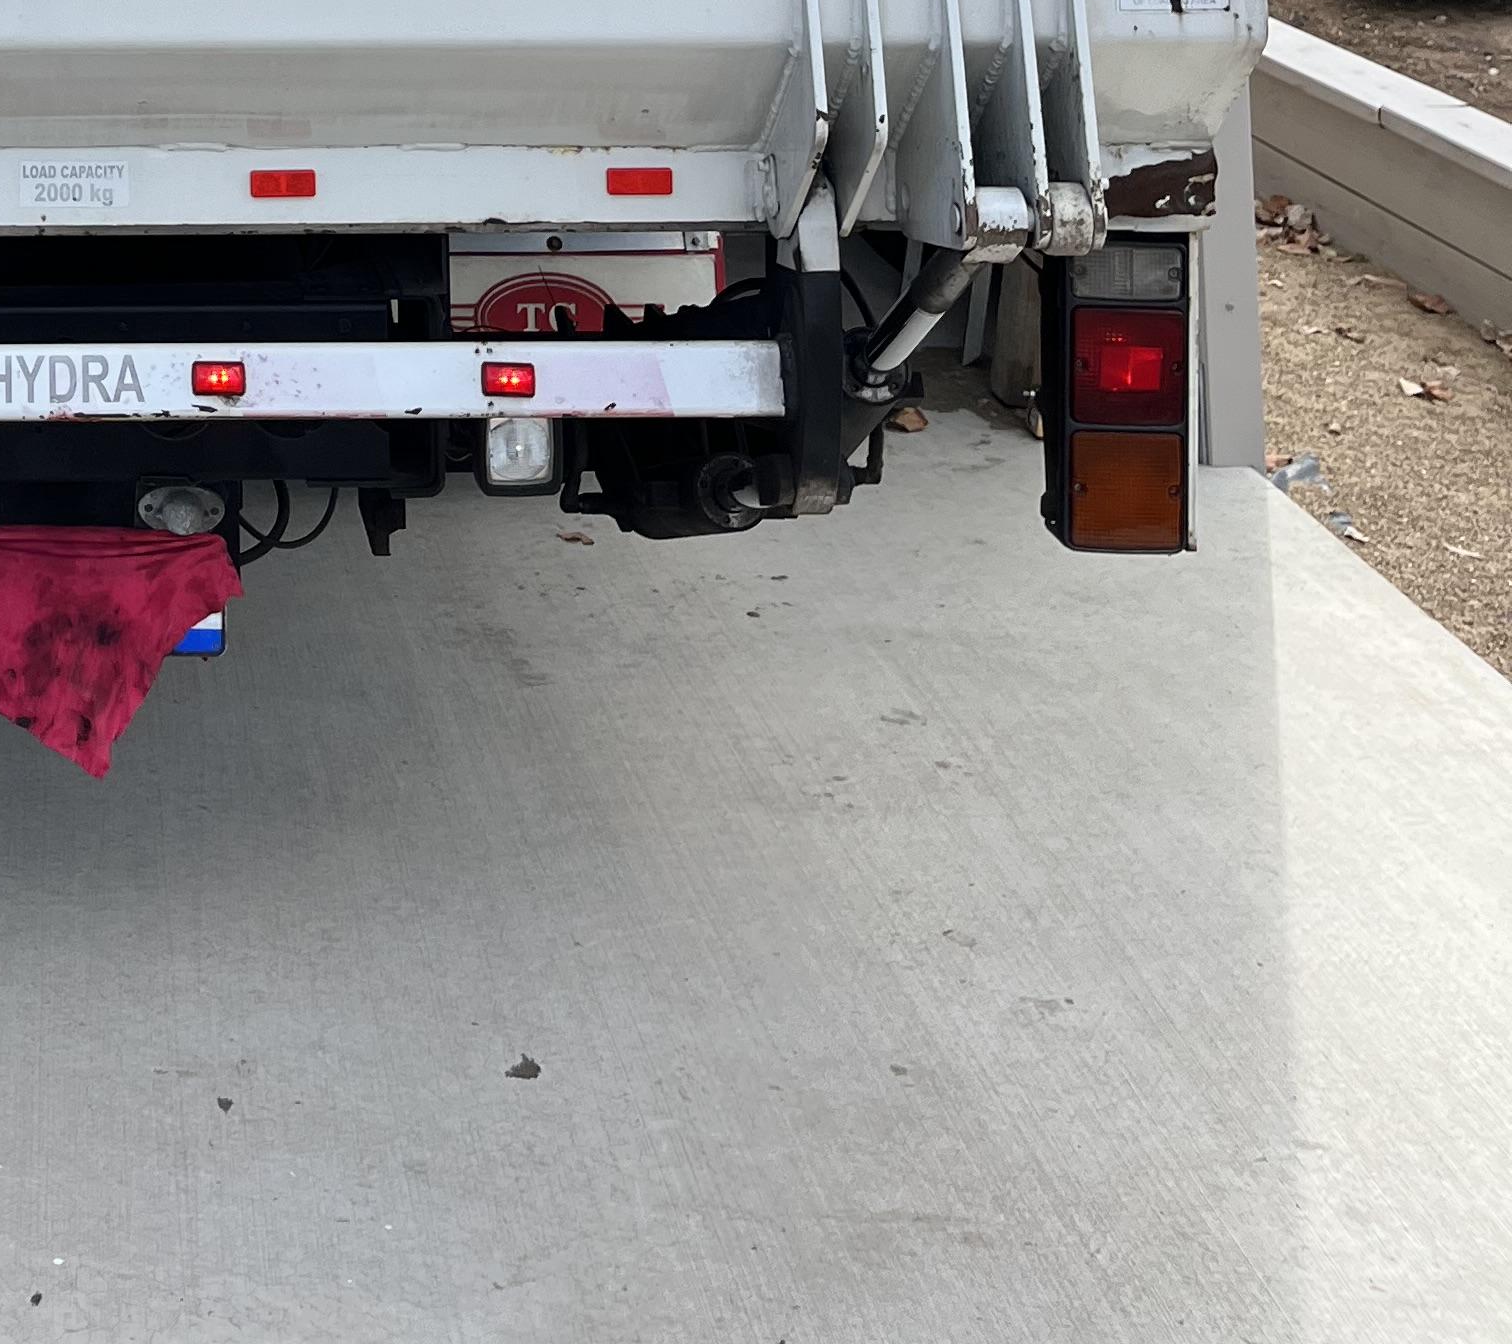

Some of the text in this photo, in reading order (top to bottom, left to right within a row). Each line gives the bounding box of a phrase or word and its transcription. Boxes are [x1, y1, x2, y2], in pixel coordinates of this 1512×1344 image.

[22, 165, 125, 179] LOAD CAPACITY
[34, 183, 114, 207] 2000 kg
